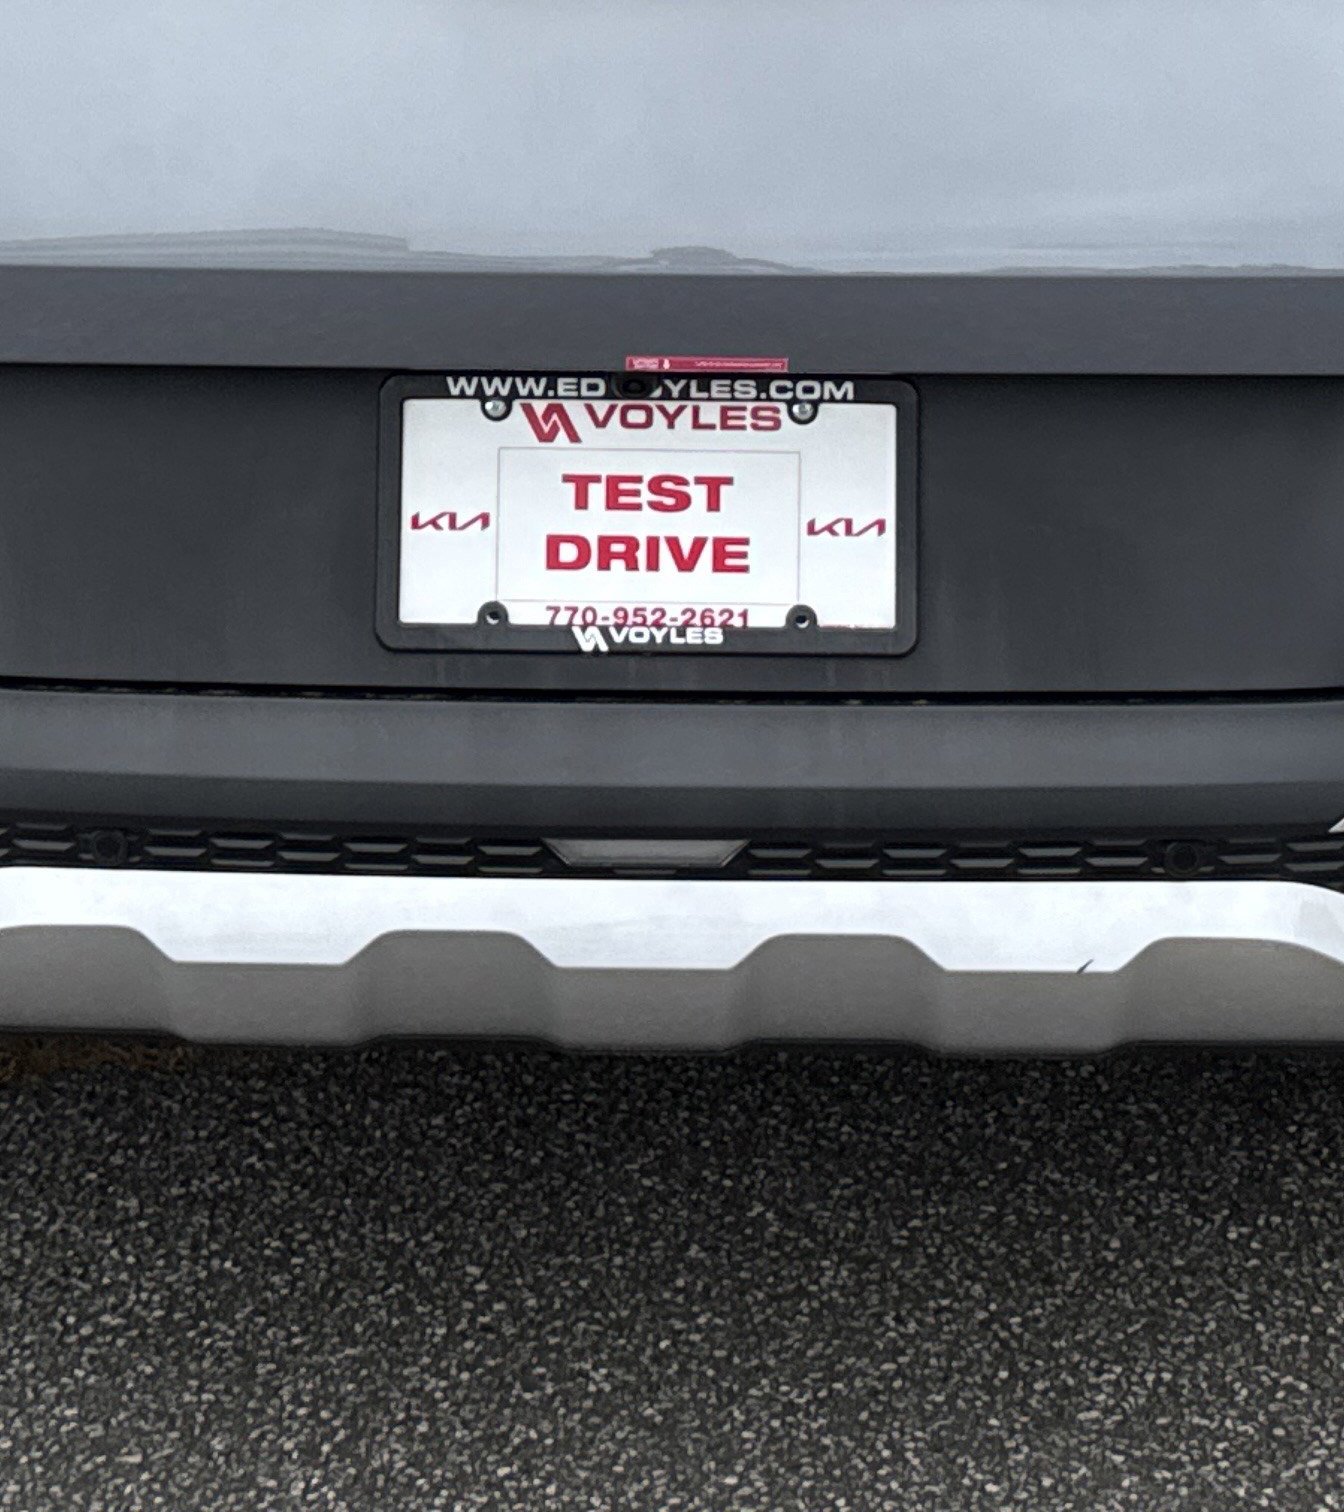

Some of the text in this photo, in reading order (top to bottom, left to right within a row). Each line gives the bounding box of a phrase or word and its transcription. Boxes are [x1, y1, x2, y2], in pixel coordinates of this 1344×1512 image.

[446, 375, 855, 401] WWW.EDYLES.COM
[584, 403, 782, 432] VOYLES
[562, 474, 734, 512] TEST
[411, 511, 490, 531] KIA
[806, 517, 886, 537] KIA
[545, 534, 750, 574] DRIVE
[546, 605, 749, 628] 770-952-2621
[609, 626, 724, 645] VOYLES
